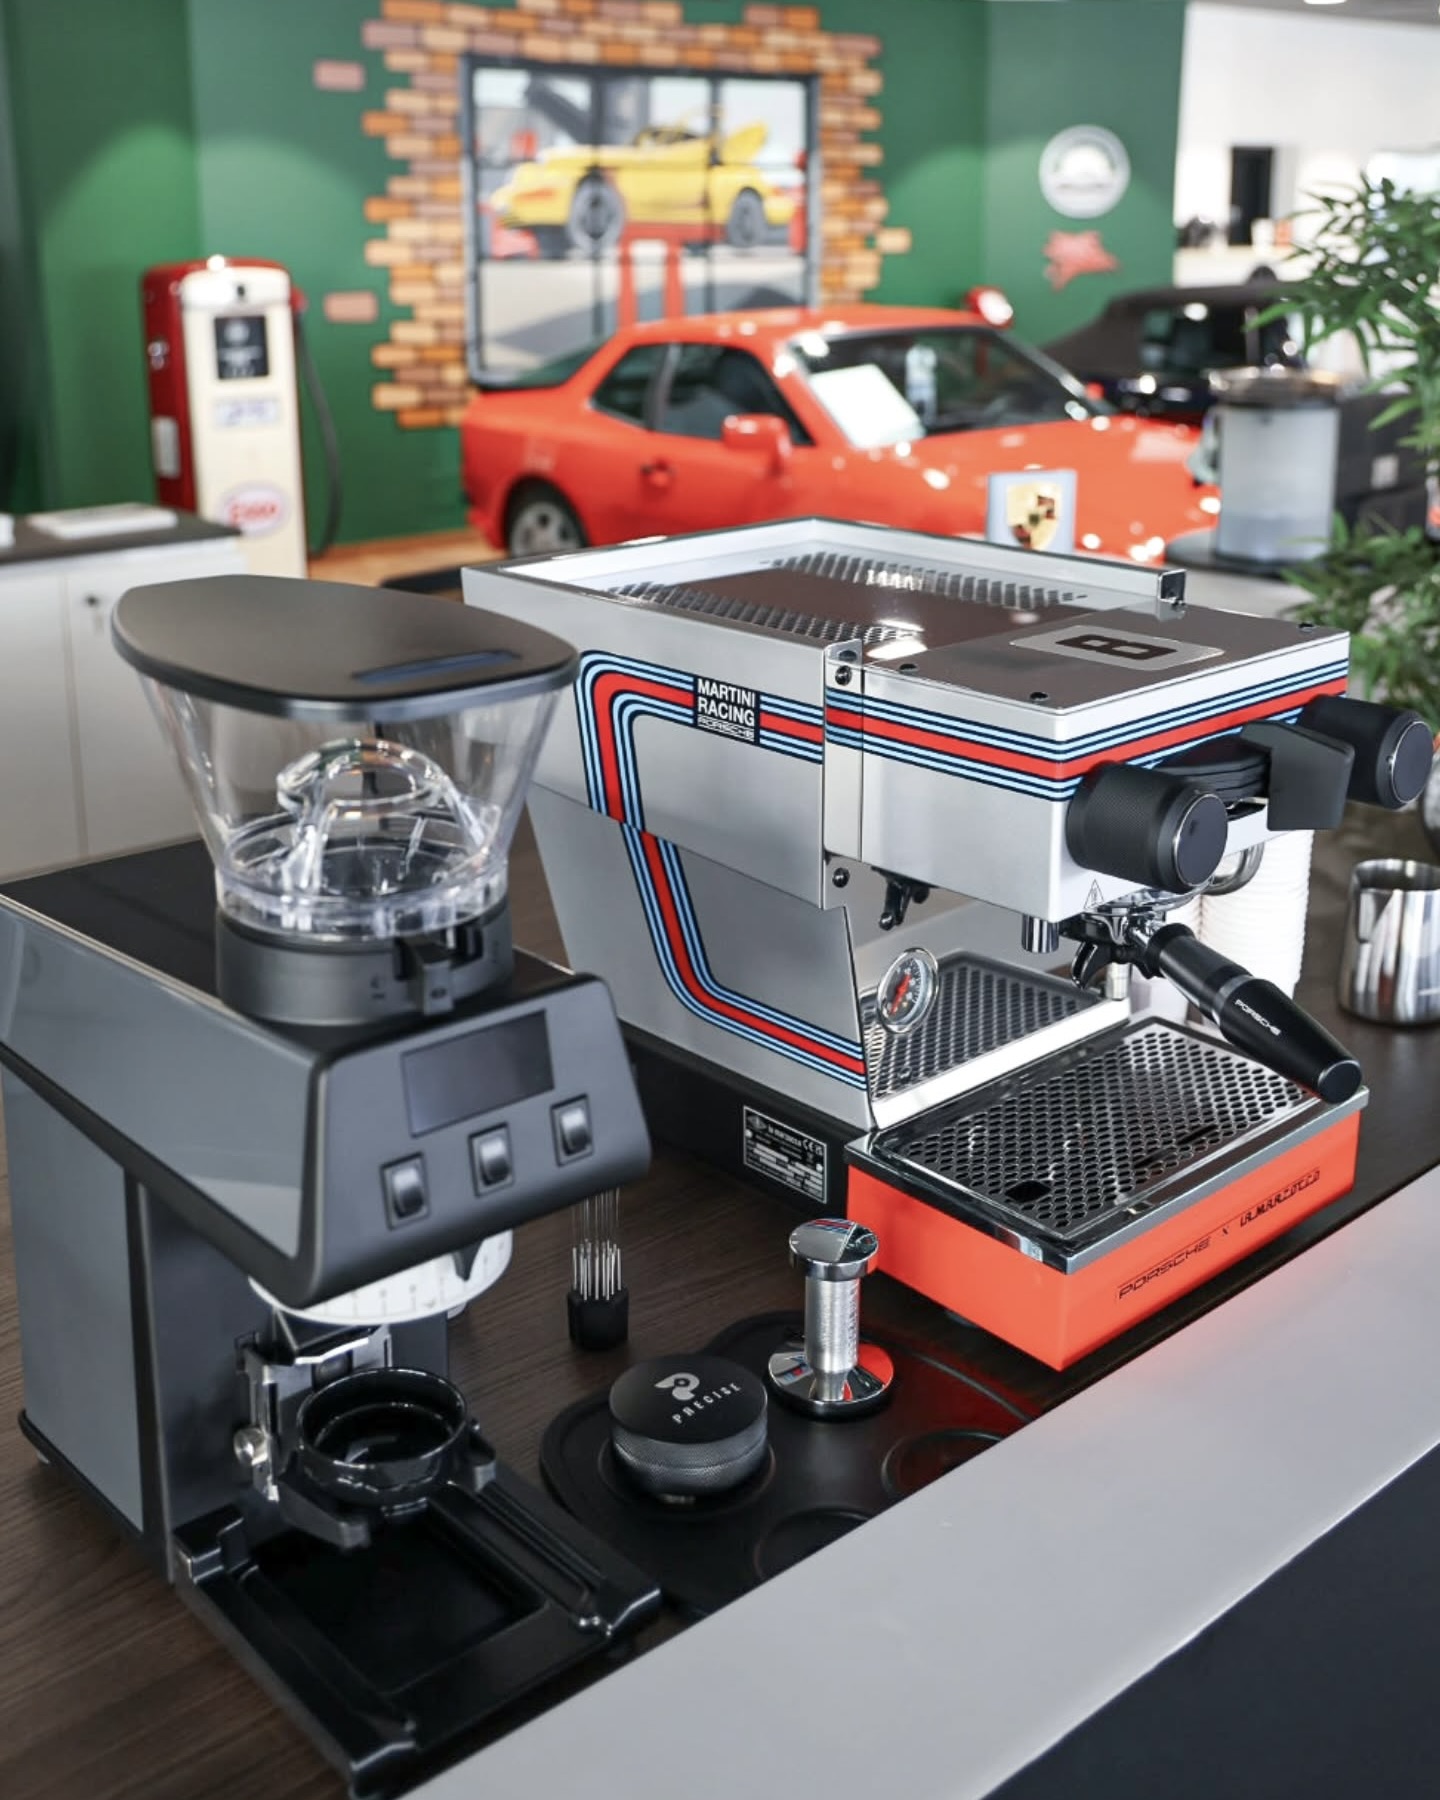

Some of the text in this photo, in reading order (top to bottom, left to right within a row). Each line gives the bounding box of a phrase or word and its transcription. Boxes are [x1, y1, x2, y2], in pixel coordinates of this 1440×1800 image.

[698, 679, 755, 709] MARTINI
[698, 696, 755, 727] RACING
[1234, 999, 1281, 1036] PORSCHE
[1118, 1236, 1211, 1299] PORSCHE
[671, 1382, 742, 1424] PRECISE
